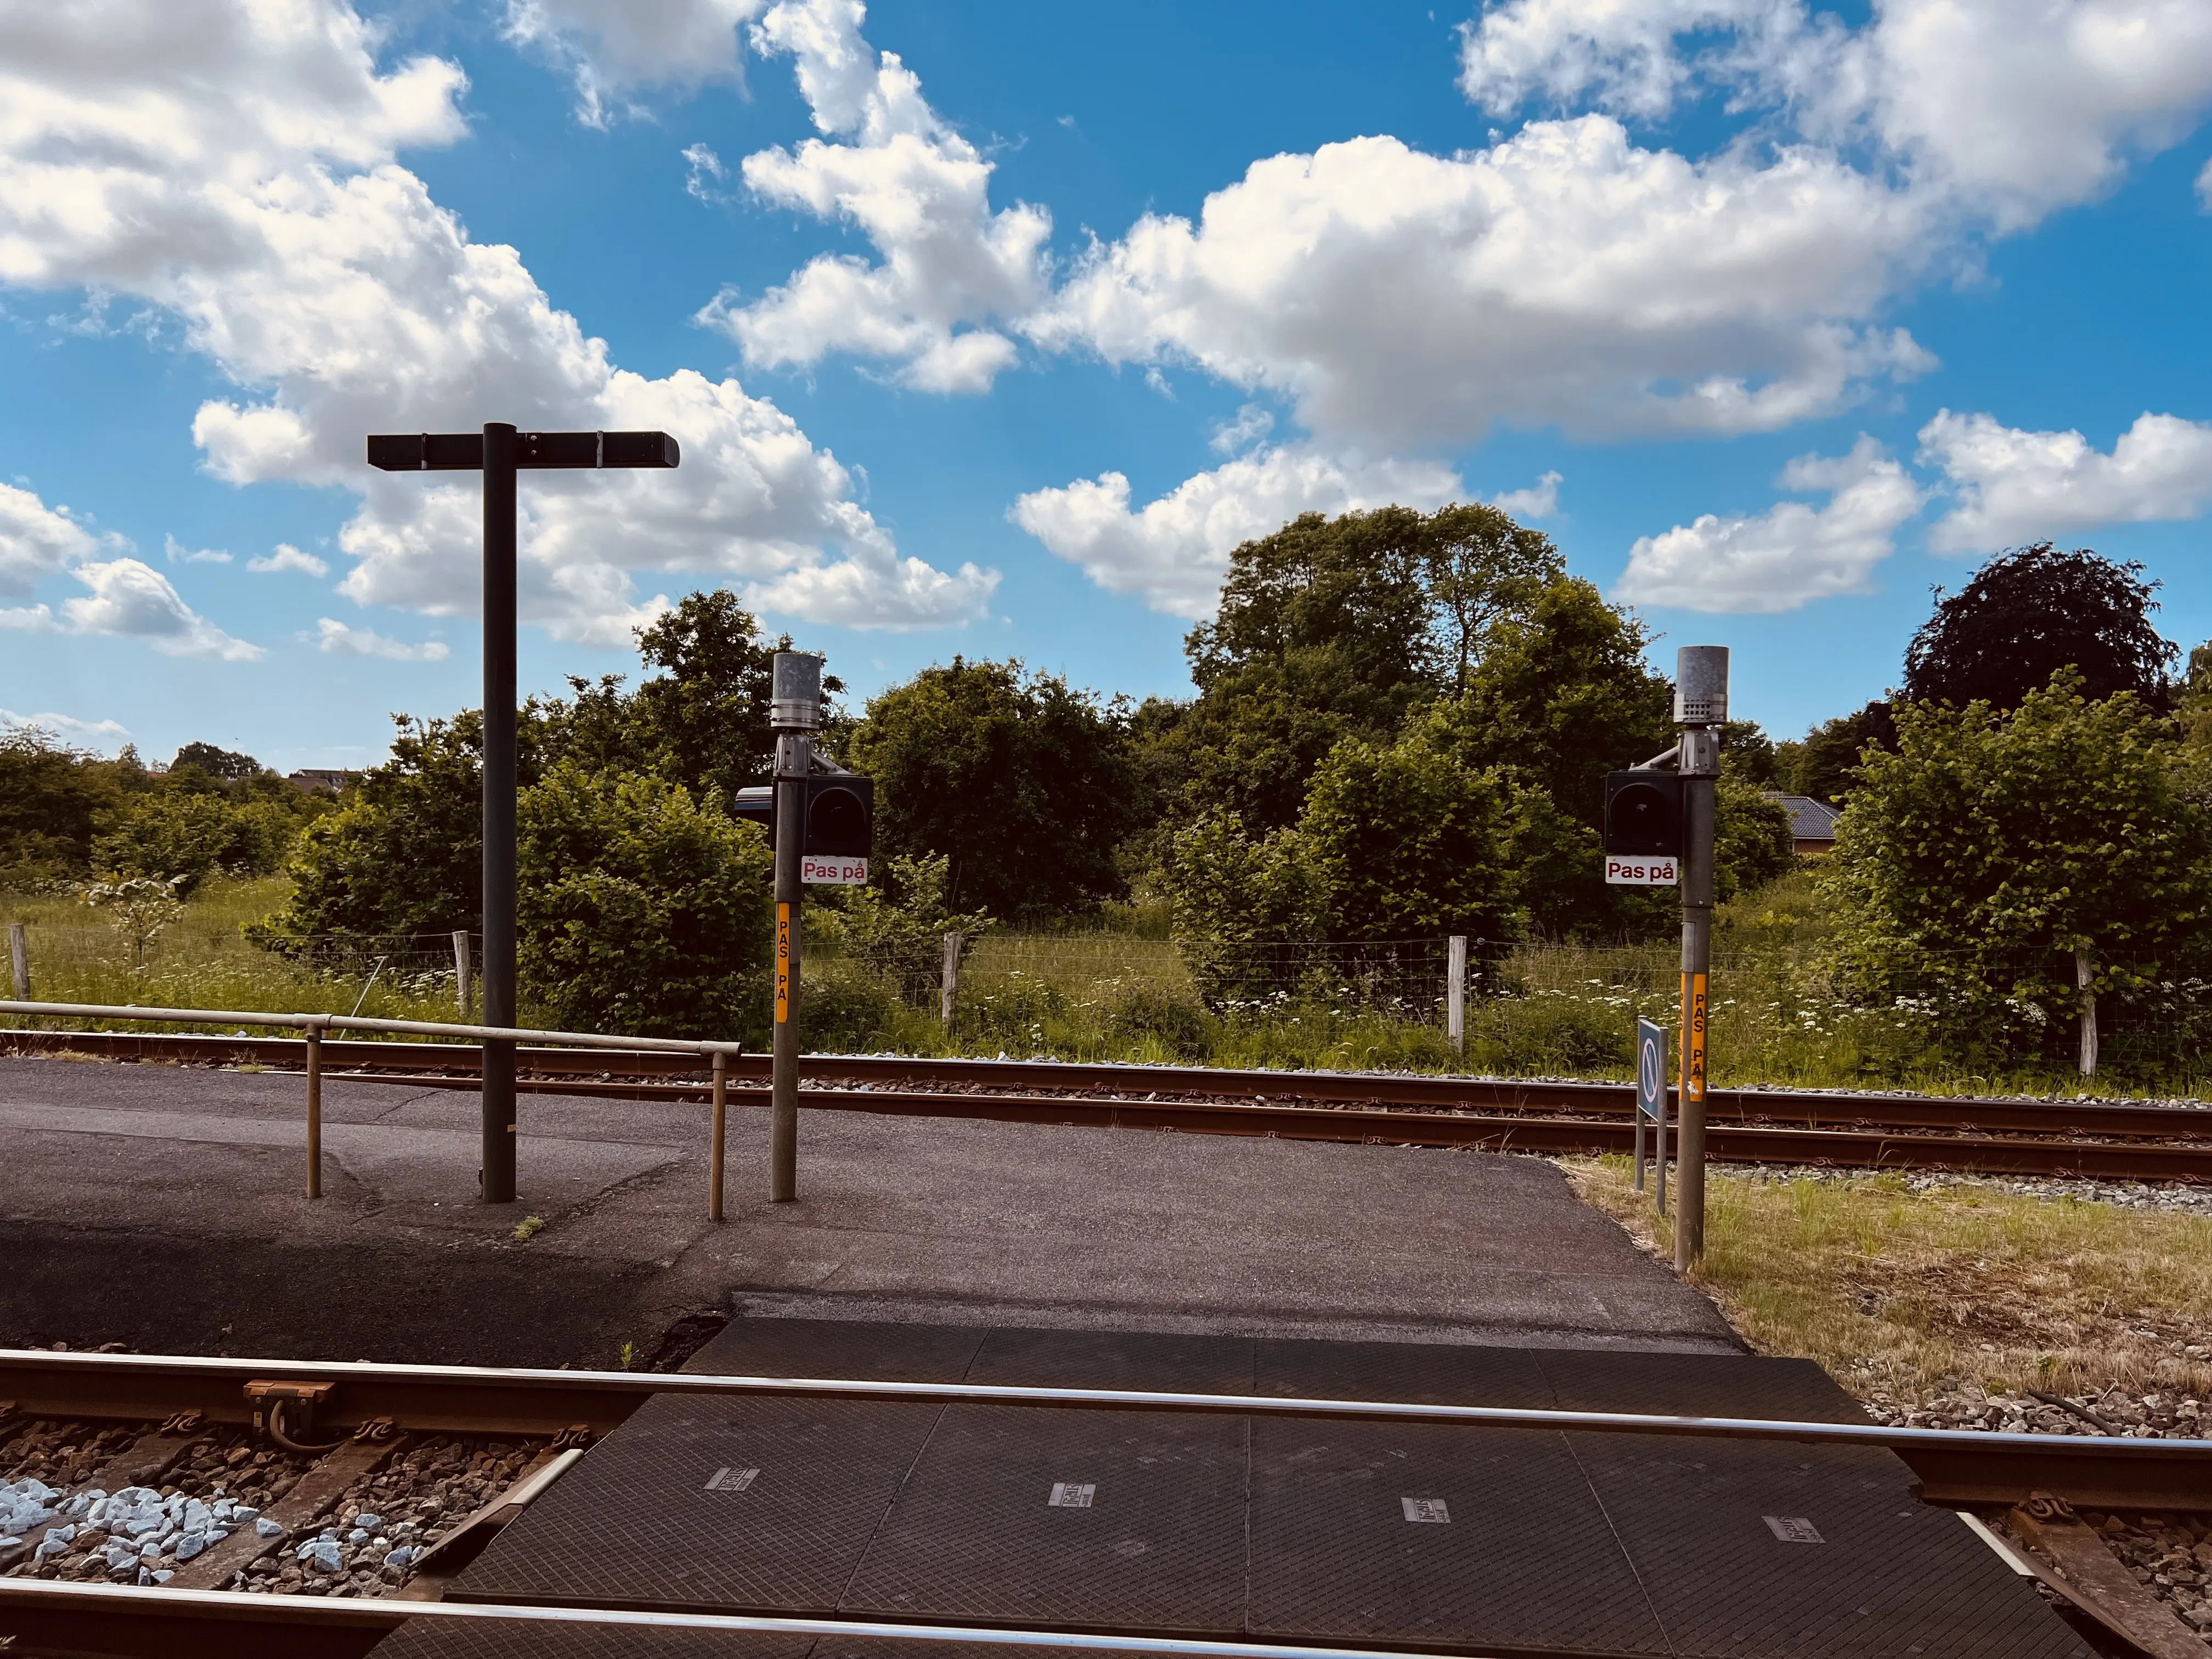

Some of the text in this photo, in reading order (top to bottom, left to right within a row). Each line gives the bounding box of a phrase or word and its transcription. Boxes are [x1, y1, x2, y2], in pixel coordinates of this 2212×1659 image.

[804, 862, 865, 882] Pas på
[1609, 862, 1674, 882] Pas på
[777, 921, 788, 1001] PAS PÅ
[1692, 994, 1705, 1076] PAS PÅ
